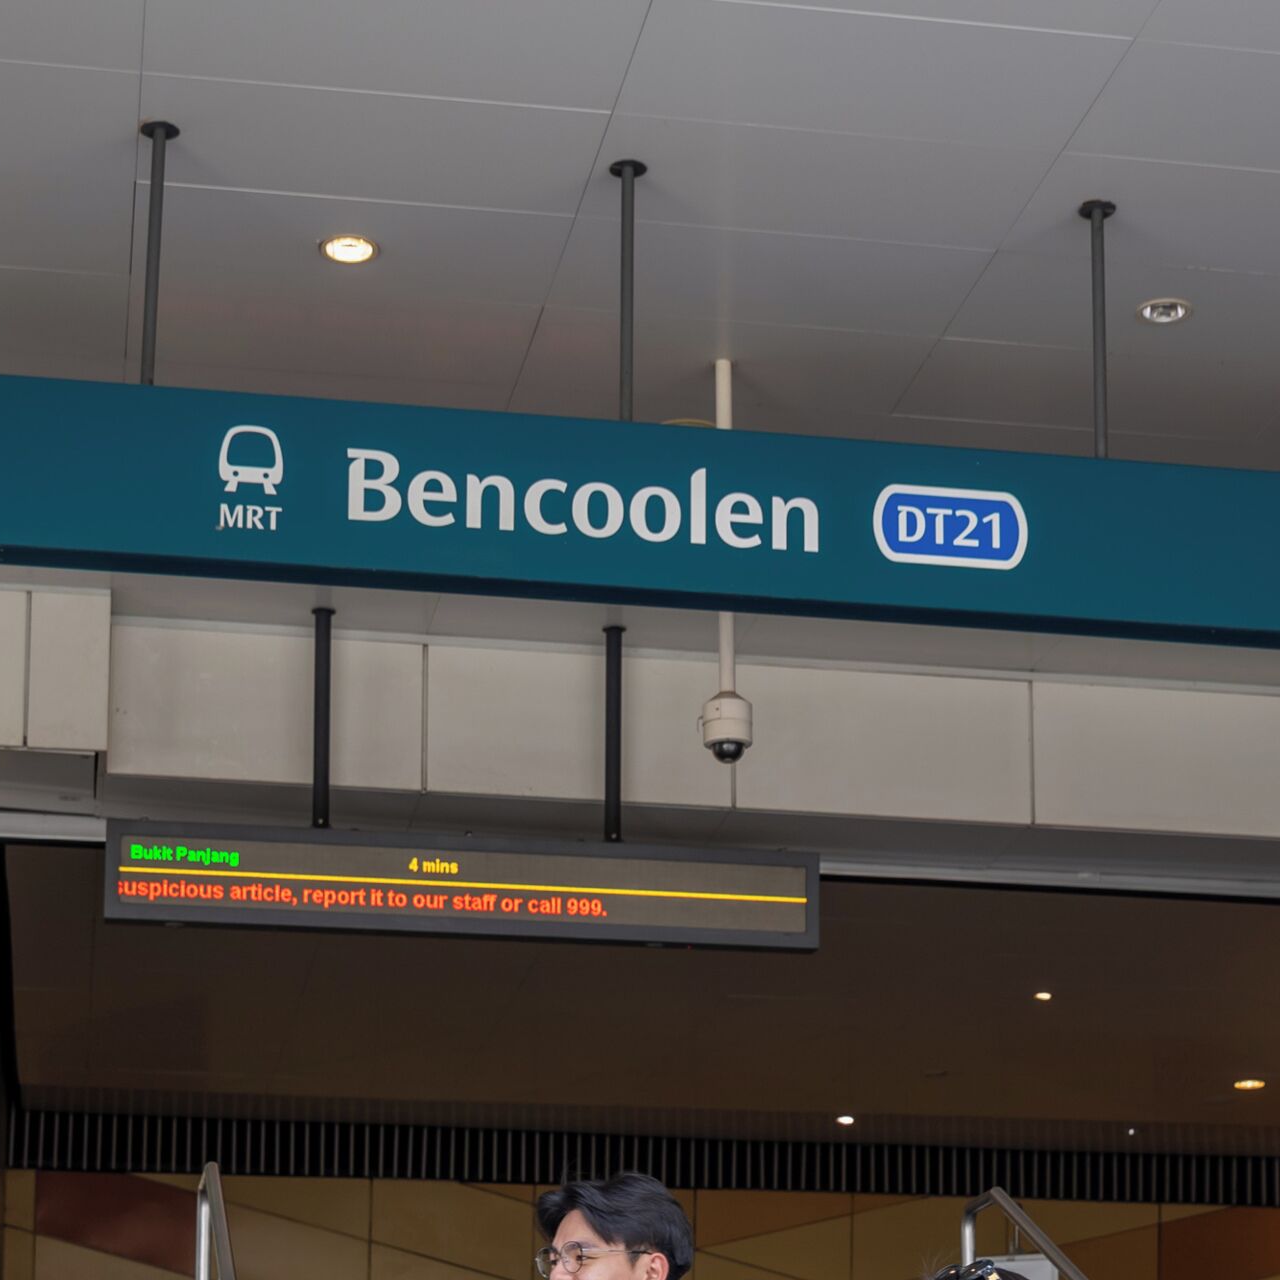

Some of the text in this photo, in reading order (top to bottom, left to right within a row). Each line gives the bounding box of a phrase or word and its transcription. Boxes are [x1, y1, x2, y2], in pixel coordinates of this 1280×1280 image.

[346, 447, 1005, 553] Bencoolen DT21
[219, 503, 283, 531] MRT
[130, 843, 459, 875] Bukit Panjang 4 mins
[229, 883, 298, 906] article,
[302, 887, 366, 908] report
[370, 888, 383, 907] it
[388, 889, 407, 908] to
[412, 893, 448, 910] our
[452, 893, 498, 911] staff
[501, 896, 523, 913] or
[527, 897, 562, 915] call
[566, 898, 608, 917] 999.
